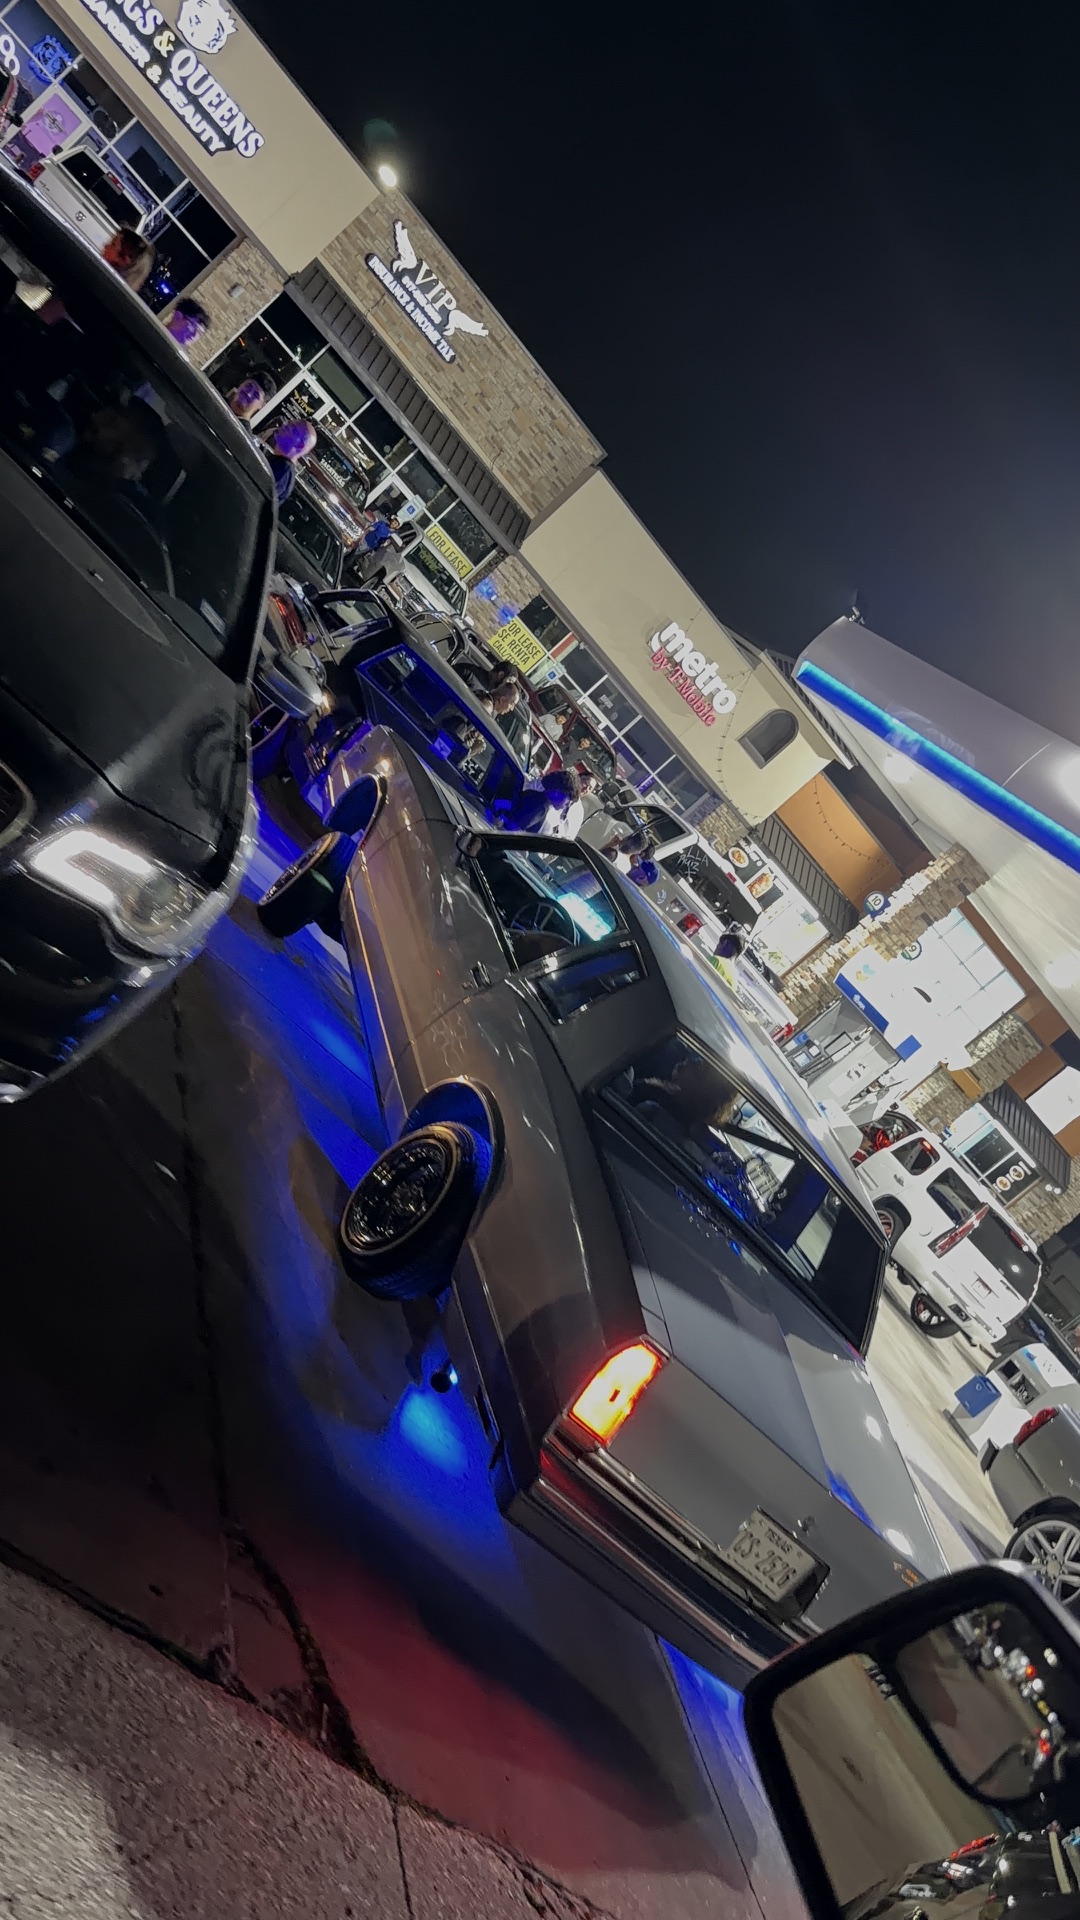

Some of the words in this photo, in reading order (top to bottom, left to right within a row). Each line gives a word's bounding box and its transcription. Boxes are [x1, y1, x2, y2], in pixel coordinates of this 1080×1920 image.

[117, 0, 164, 35] GS
[153, 31, 176, 58] &
[170, 49, 265, 158] QUEENS
[146, 64, 162, 84] &
[159, 79, 226, 152] BEAUTY
[415, 260, 457, 311] VIP
[368, 255, 411, 307] INSURANCE
[405, 301, 415, 314] &
[411, 308, 442, 344] INCOME
[436, 338, 456, 362] TAX
[429, 530, 447, 549] FOR
[443, 546, 468, 575] LEASE
[498, 628, 511, 643] SE
[507, 639, 530, 665] RENTA
[517, 633, 541, 659] LEASE
[651, 646, 671, 672] by
[652, 621, 737, 714] metro
[871, 895, 882, 907] 10
[908, 944, 917, 953] 9
[765, 1528, 793, 1554] TEXAS
